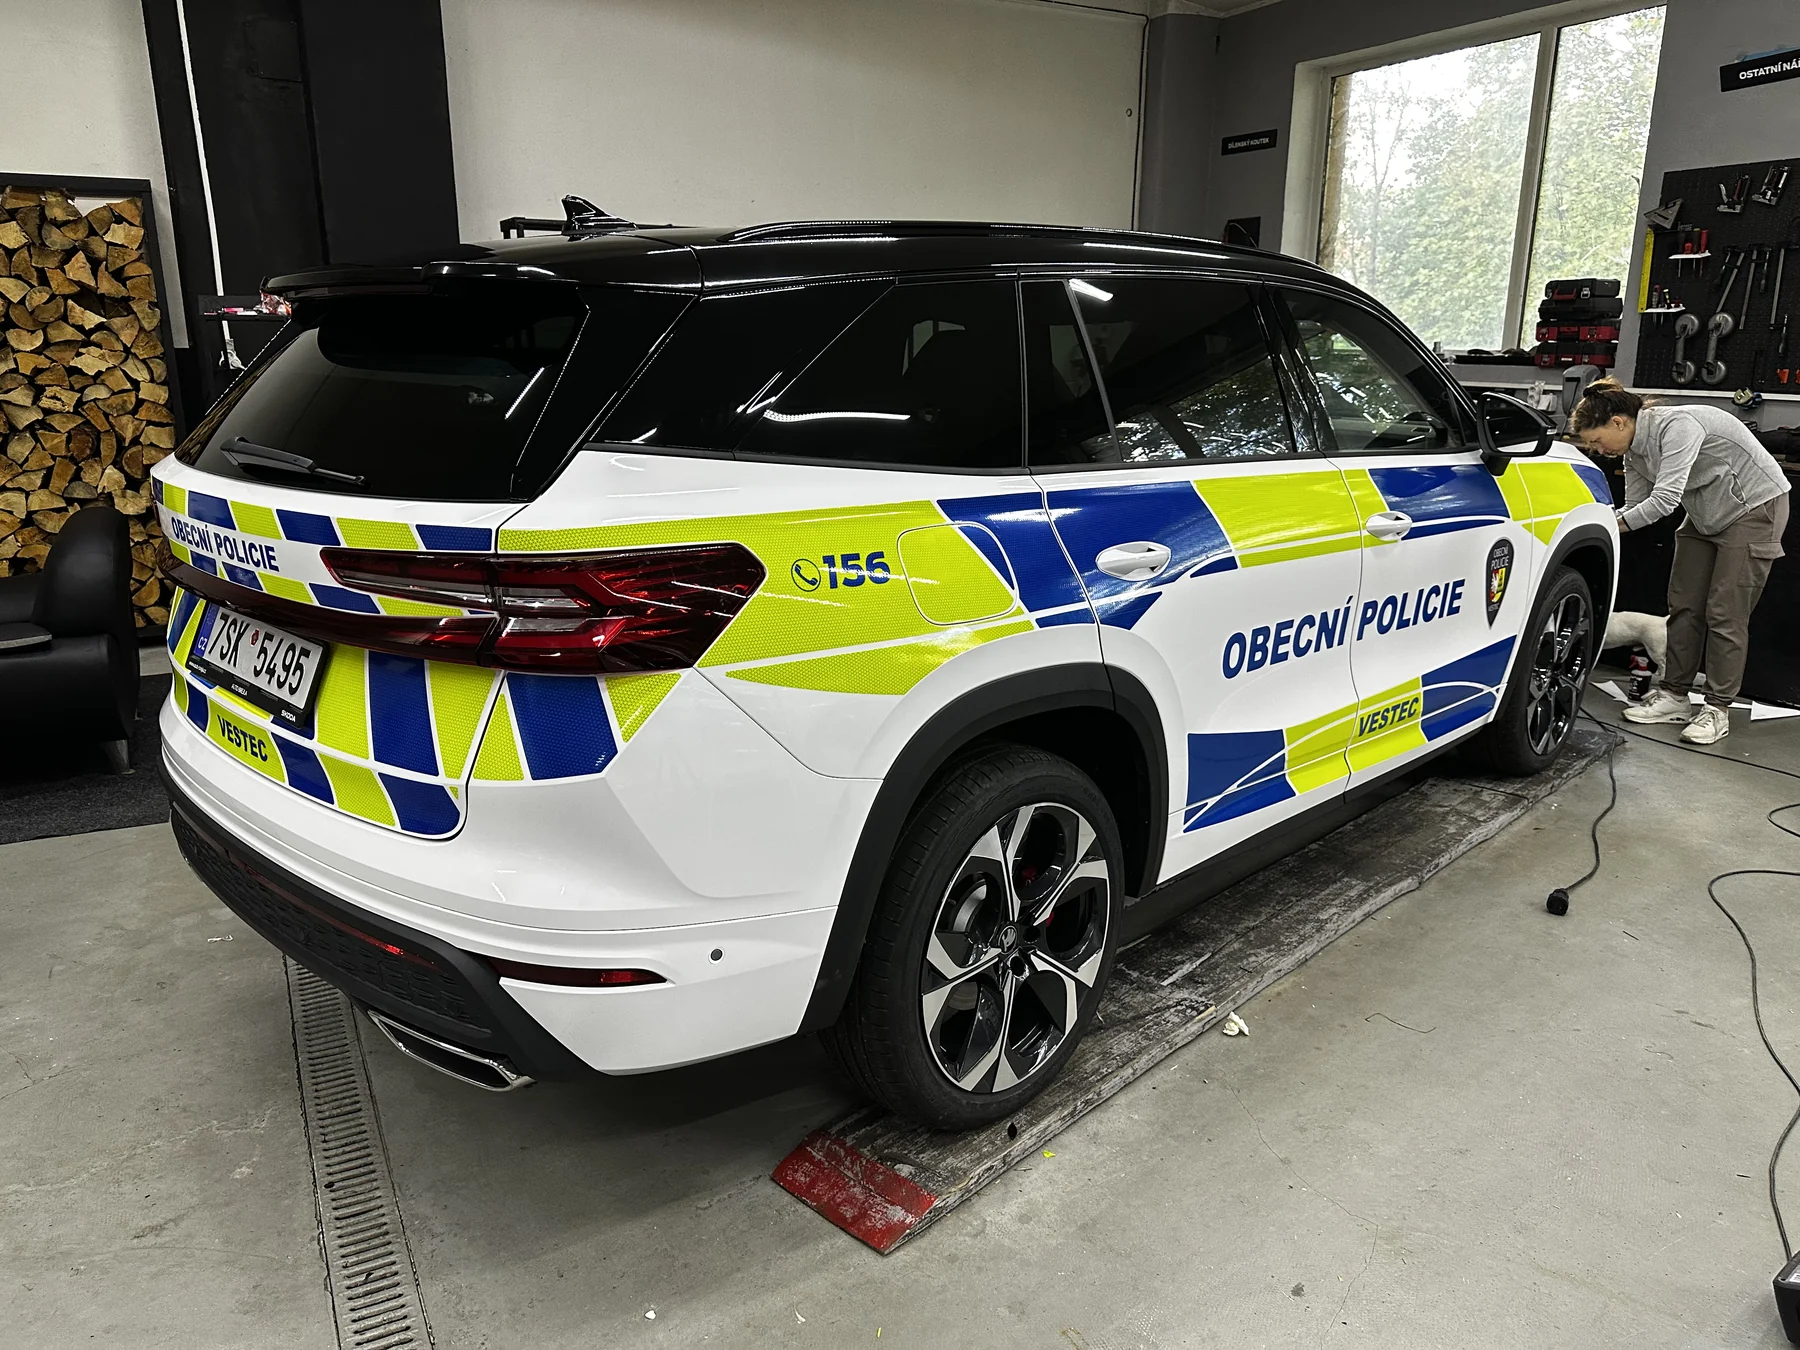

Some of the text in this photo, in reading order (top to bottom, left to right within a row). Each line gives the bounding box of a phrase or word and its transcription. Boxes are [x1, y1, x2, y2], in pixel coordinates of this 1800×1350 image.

[1739, 61, 1782, 80] OSTATNÍ
[171, 516, 280, 572] OBECNÍ POLICIE
[1491, 556, 1510, 571] POLICIE
[822, 551, 891, 589] 156
[1222, 578, 1466, 679] OBECNÍ POLICIE
[198, 612, 311, 696] CZ 7SK 5495
[217, 714, 268, 762] VESTEC
[1358, 697, 1420, 736] VESTEC
